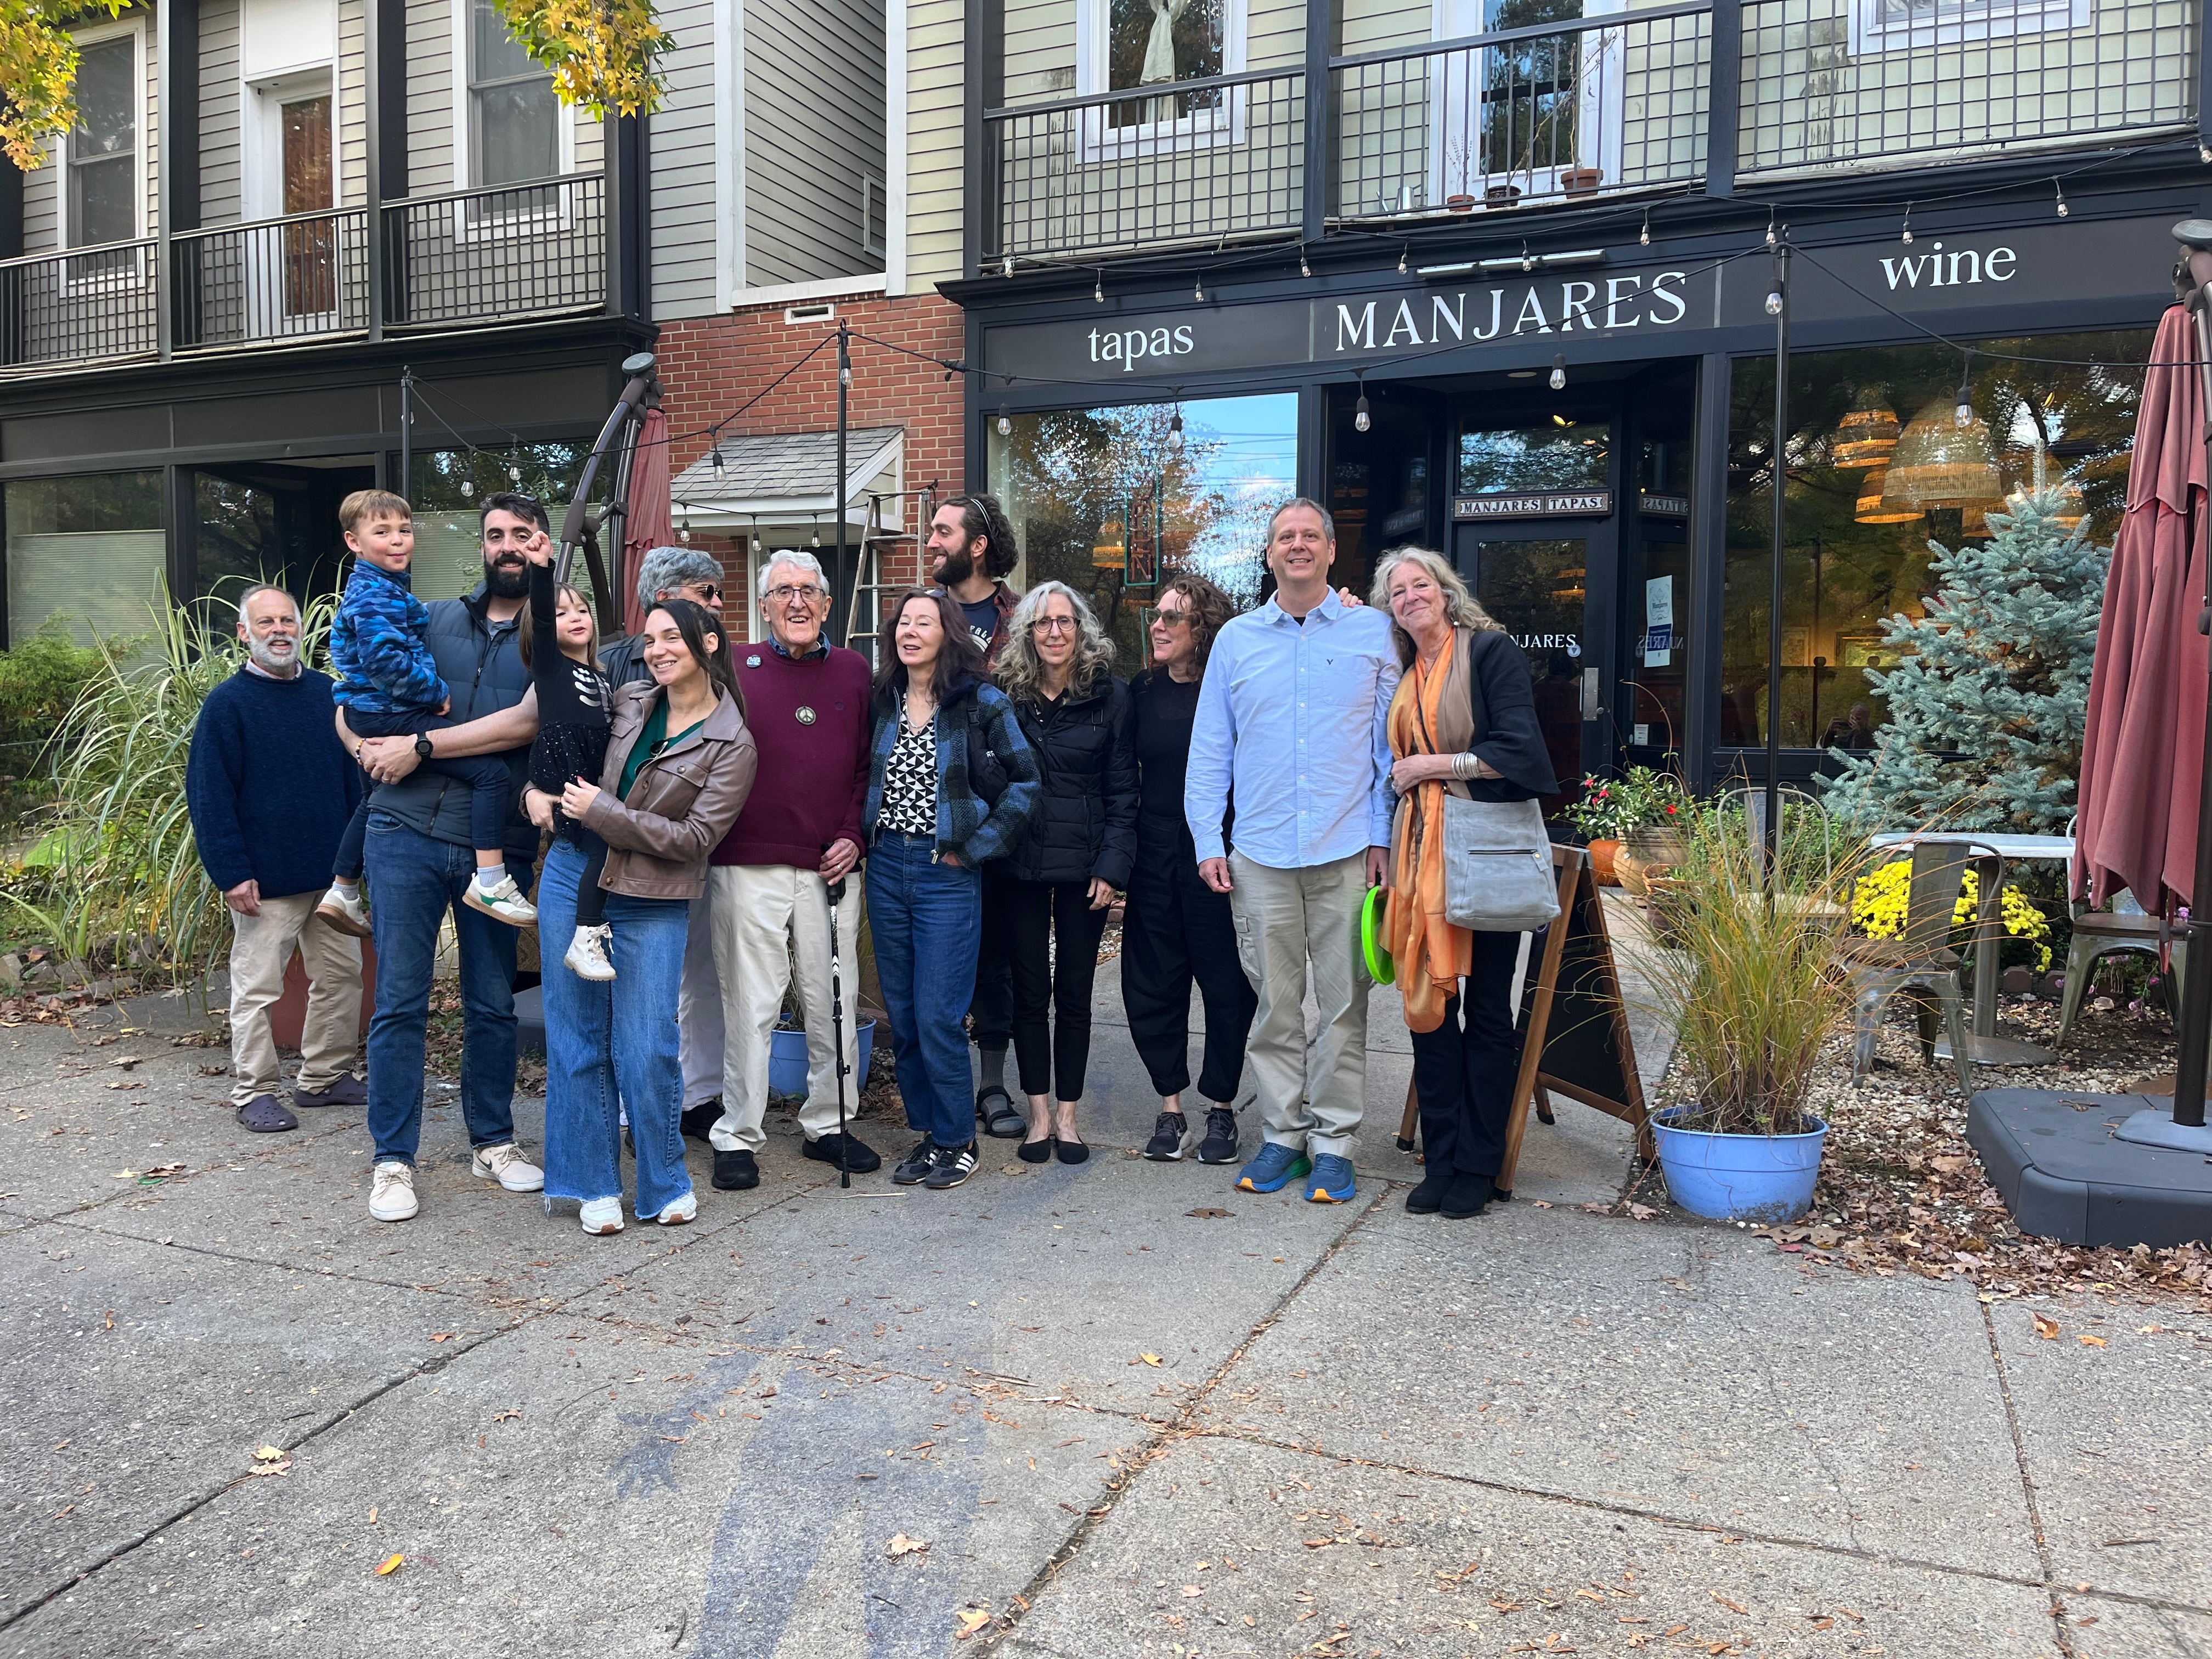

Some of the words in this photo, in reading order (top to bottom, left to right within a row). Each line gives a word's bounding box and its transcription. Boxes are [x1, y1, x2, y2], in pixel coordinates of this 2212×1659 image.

[1879, 241, 2016, 290] wine
[1335, 272, 1686, 351] MANJARES
[1088, 325, 1194, 371] tapas
[1464, 500, 1539, 512] MANJARES
[1550, 498, 1598, 509] TAPAS
[1510, 634, 1576, 648] NJARES
